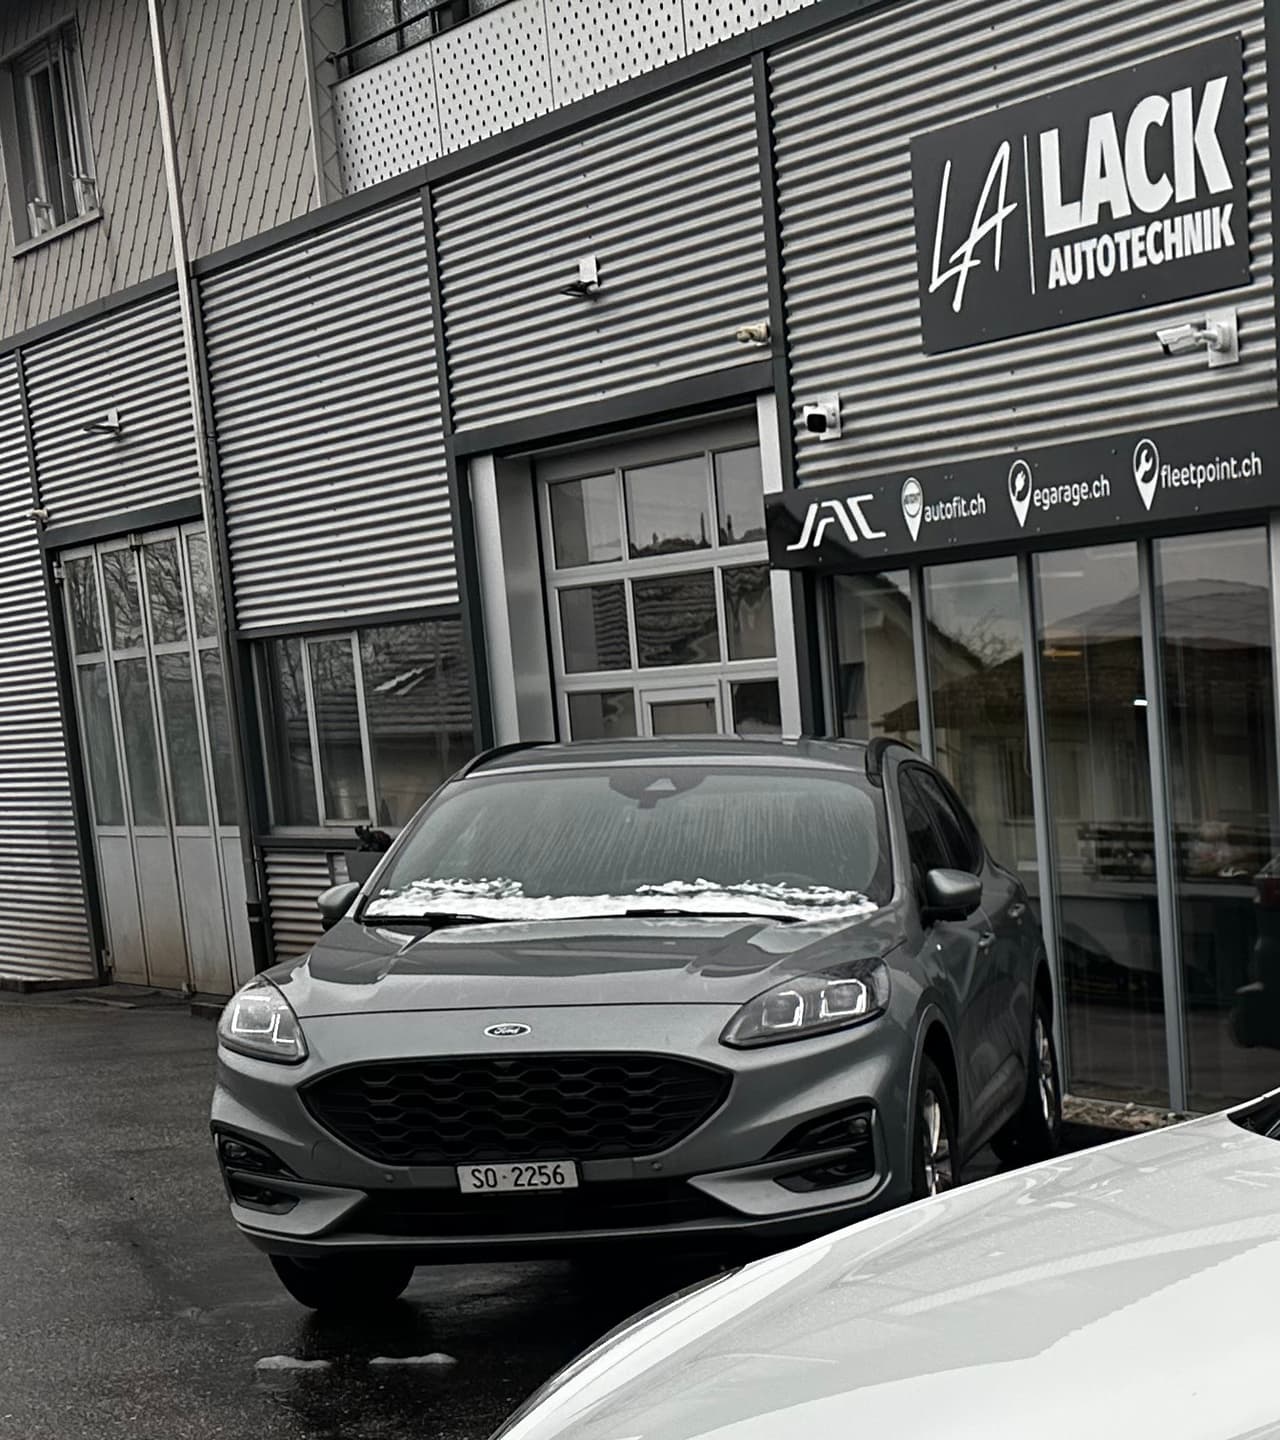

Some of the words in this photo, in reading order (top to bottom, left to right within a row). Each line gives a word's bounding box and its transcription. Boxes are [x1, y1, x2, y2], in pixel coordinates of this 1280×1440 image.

[1039, 76, 1234, 238] LACK
[1047, 203, 1236, 289] AUTOTECHNIK
[1160, 451, 1263, 489] fleetpoint.ch
[924, 492, 987, 523] autofit.ch
[1033, 474, 1111, 511] egarage.ch
[471, 1167, 498, 1188] SO
[511, 1164, 565, 1188] 2256
